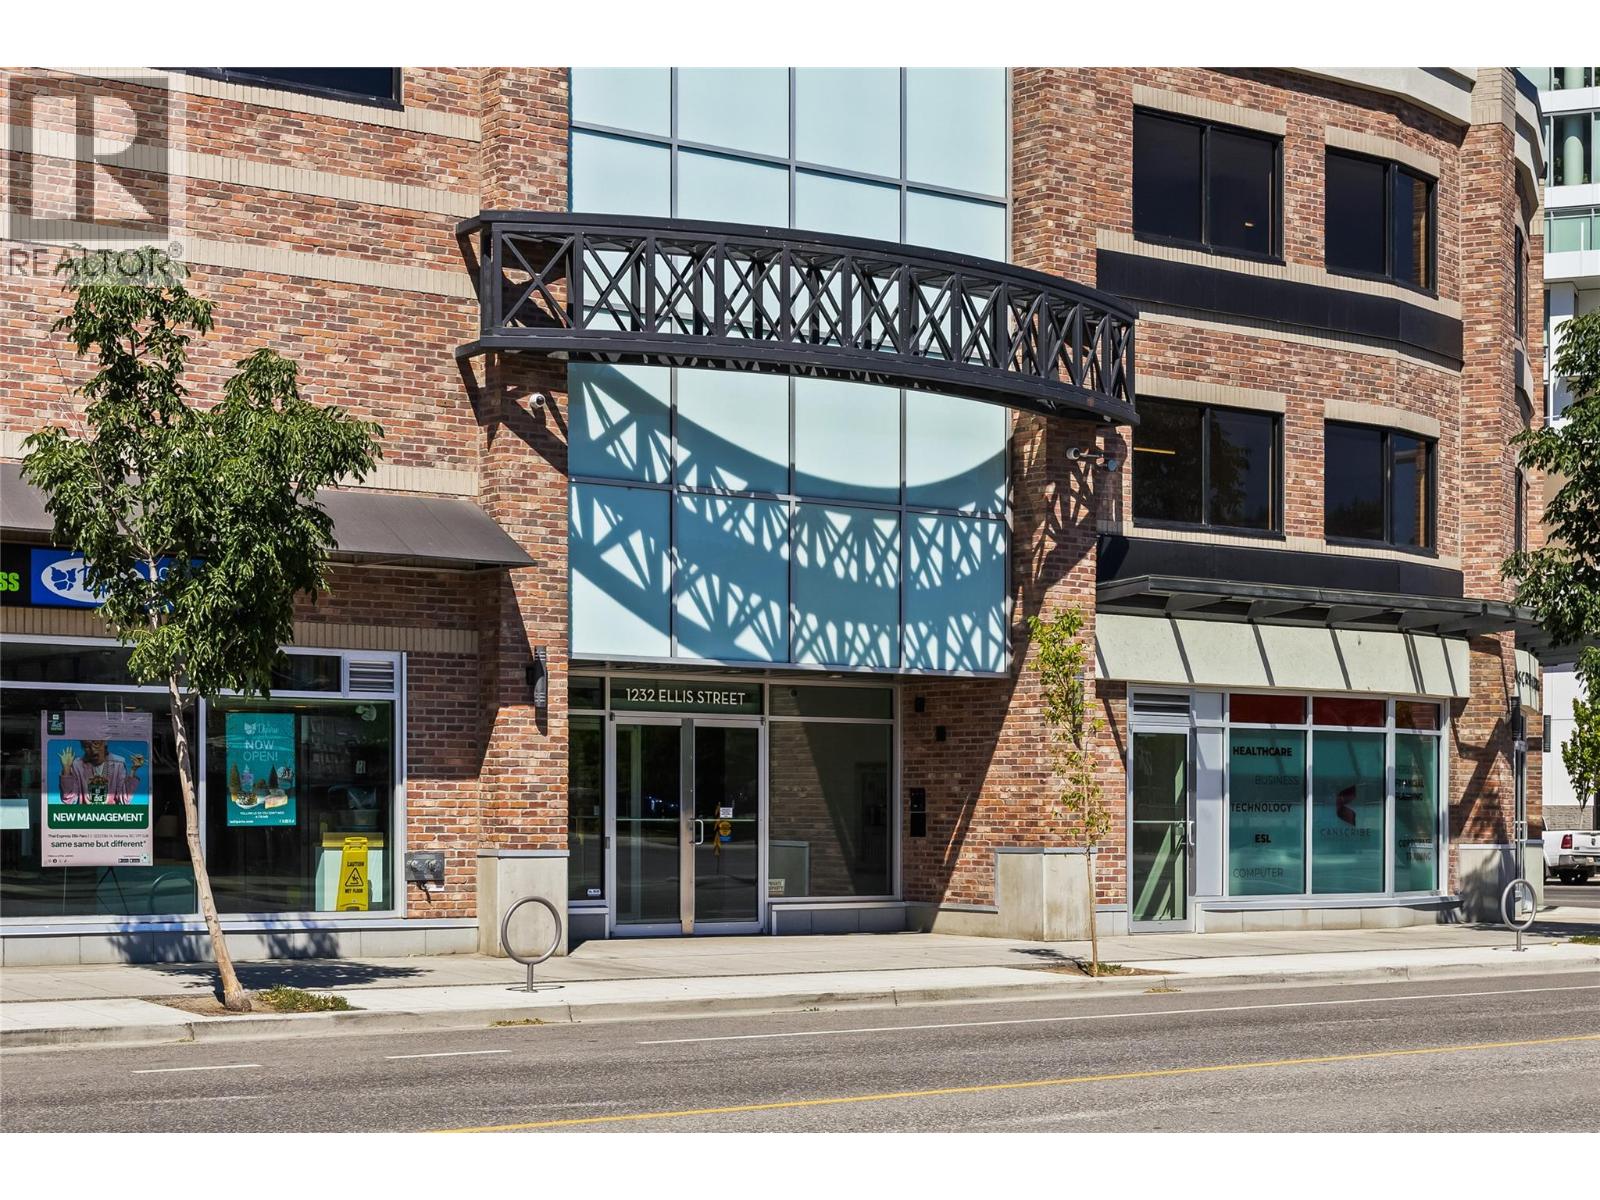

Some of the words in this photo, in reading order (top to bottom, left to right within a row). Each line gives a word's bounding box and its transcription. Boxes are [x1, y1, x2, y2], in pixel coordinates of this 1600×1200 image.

[626, 688, 655, 702] 1232
[658, 689, 694, 703] ELLIS
[697, 690, 745, 705] STREET
[245, 740, 274, 750] NOW
[243, 751, 278, 761] OPEN!
[1232, 746, 1293, 757] HEALTHCARE
[1254, 775, 1299, 785] BUSINESS
[1231, 803, 1292, 813] TECHNOLOGY
[53, 812, 76, 822] NEW
[77, 812, 144, 822] MANAGEMENT
[1320, 828, 1372, 837] CANSCRIBE
[1255, 834, 1272, 843] ESL
[51, 840, 72, 848] same
[73, 840, 95, 848] same
[96, 840, 109, 848] but
[1233, 867, 1284, 879] COMPUTER
